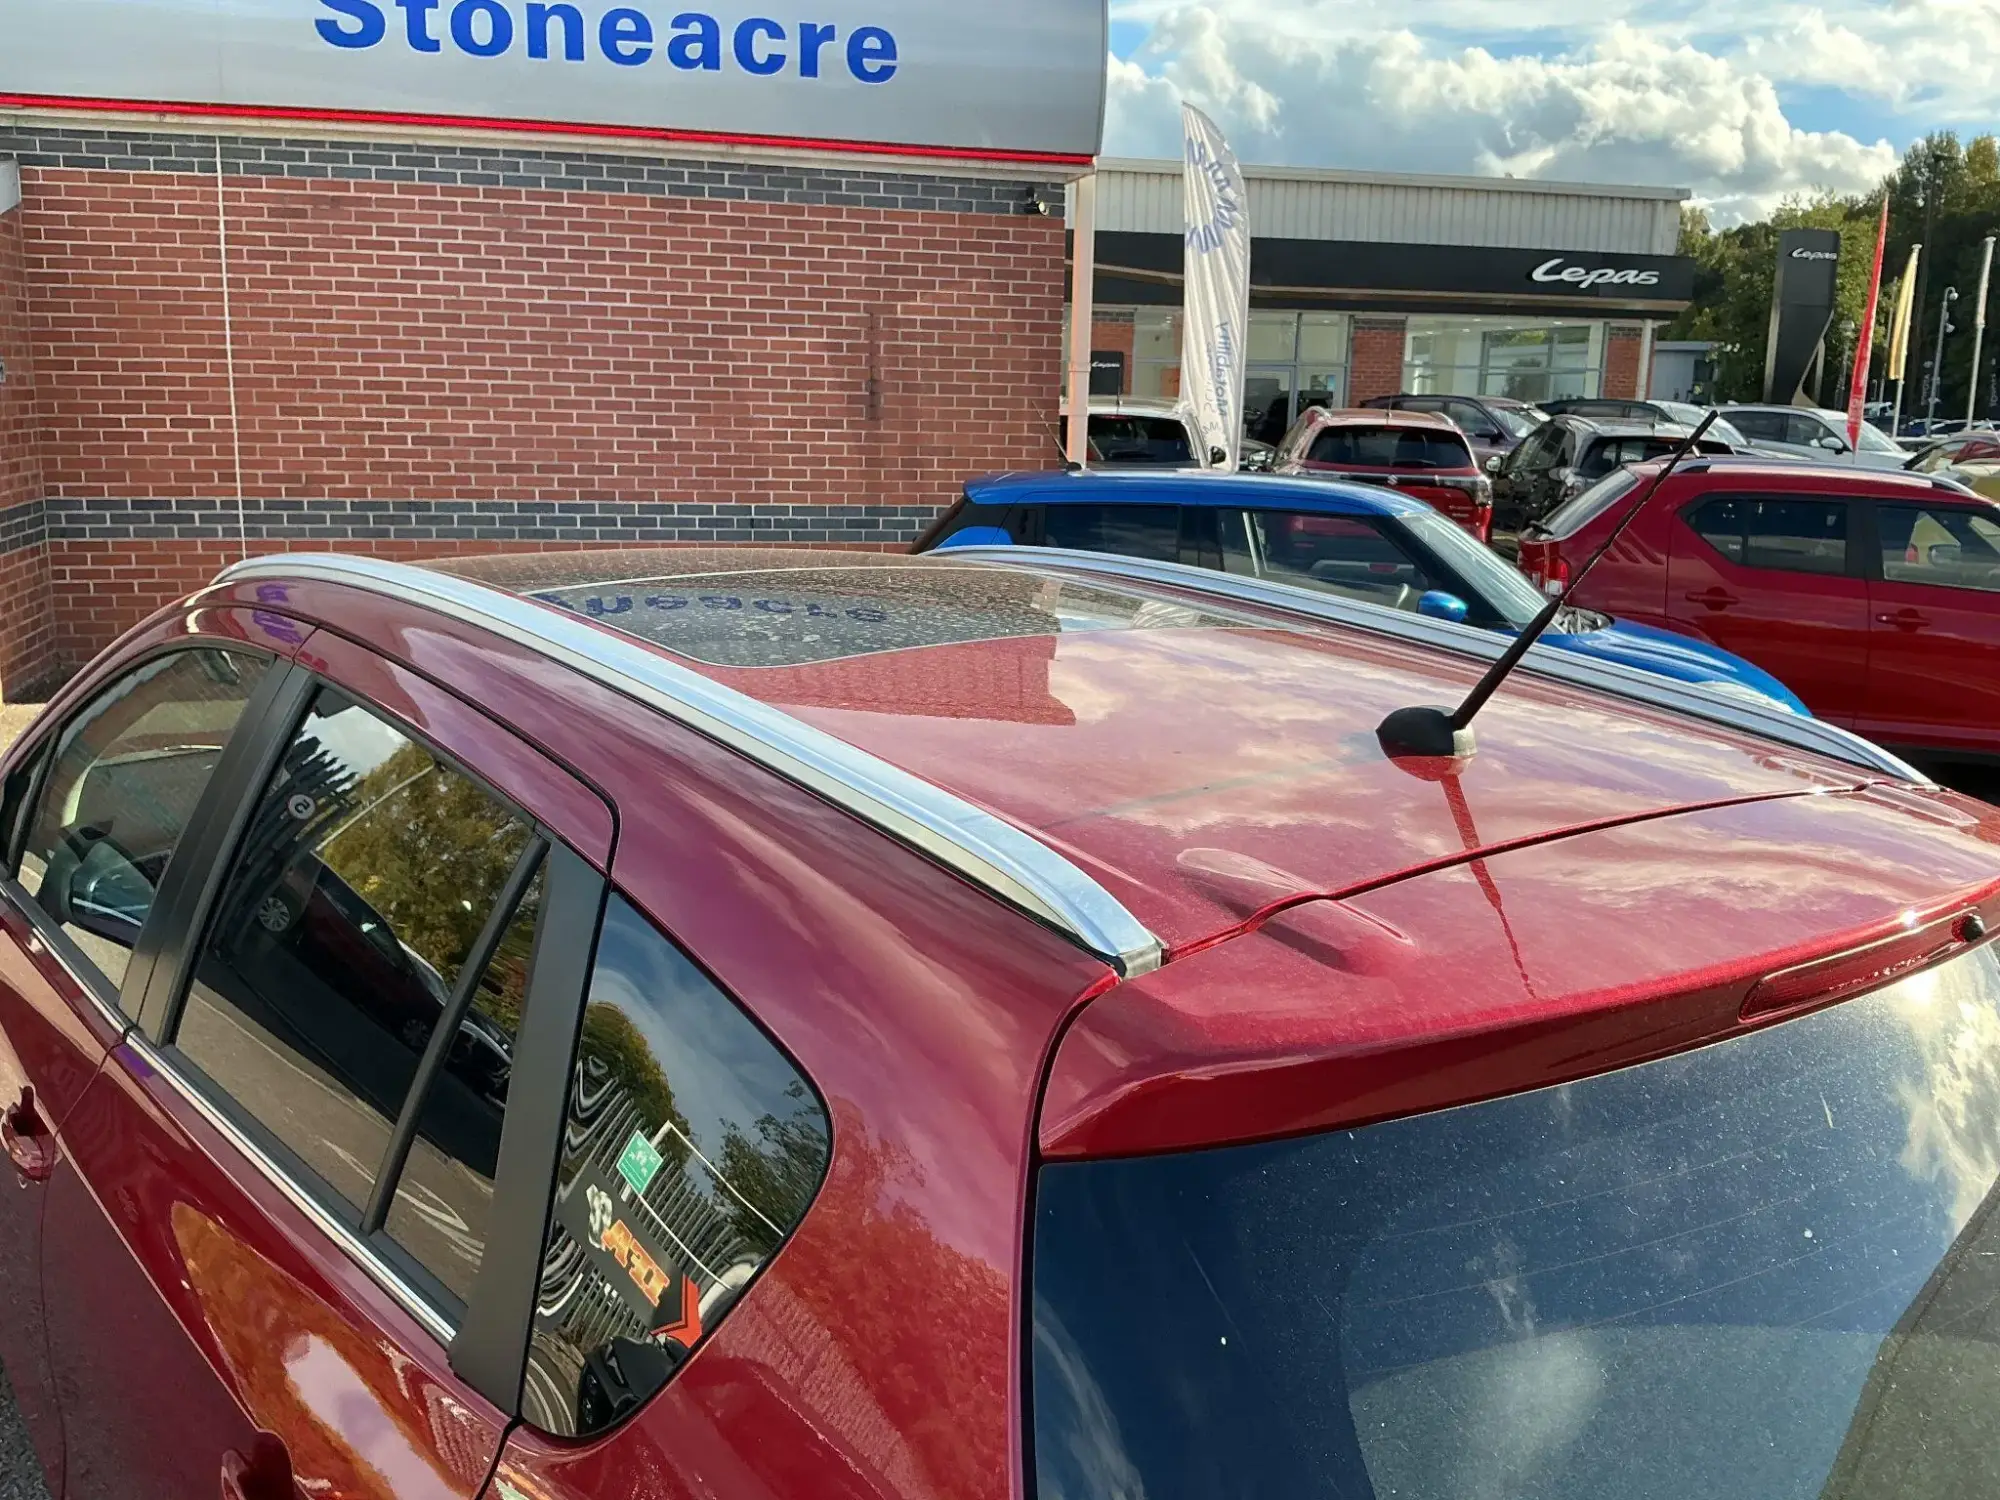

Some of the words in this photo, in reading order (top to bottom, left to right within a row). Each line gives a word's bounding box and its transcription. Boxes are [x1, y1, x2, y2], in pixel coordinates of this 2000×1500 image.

[314, 0, 899, 84] Stoneacre
[1792, 248, 1838, 260] Lepas
[1532, 258, 1660, 289] Lepas
